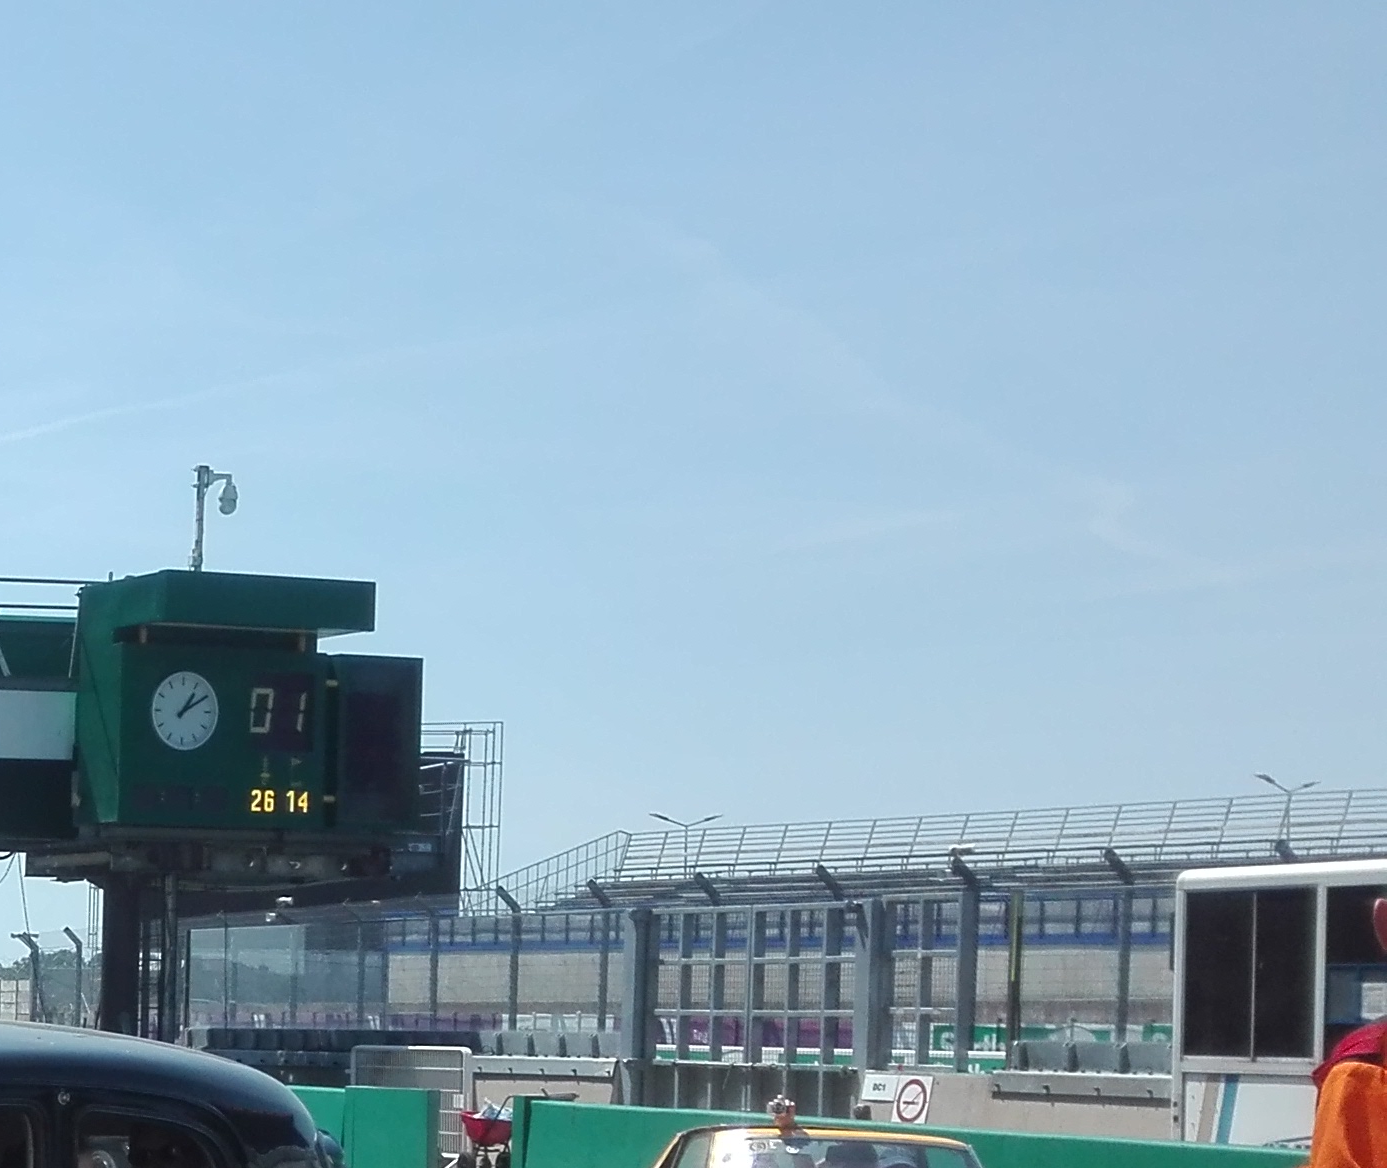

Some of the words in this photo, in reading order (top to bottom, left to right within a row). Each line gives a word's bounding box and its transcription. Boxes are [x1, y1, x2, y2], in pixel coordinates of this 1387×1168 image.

[250, 687, 308, 734] 01
[250, 789, 275, 812] 26
[286, 790, 309, 813] 14
[872, 1082, 886, 1091] DC1
